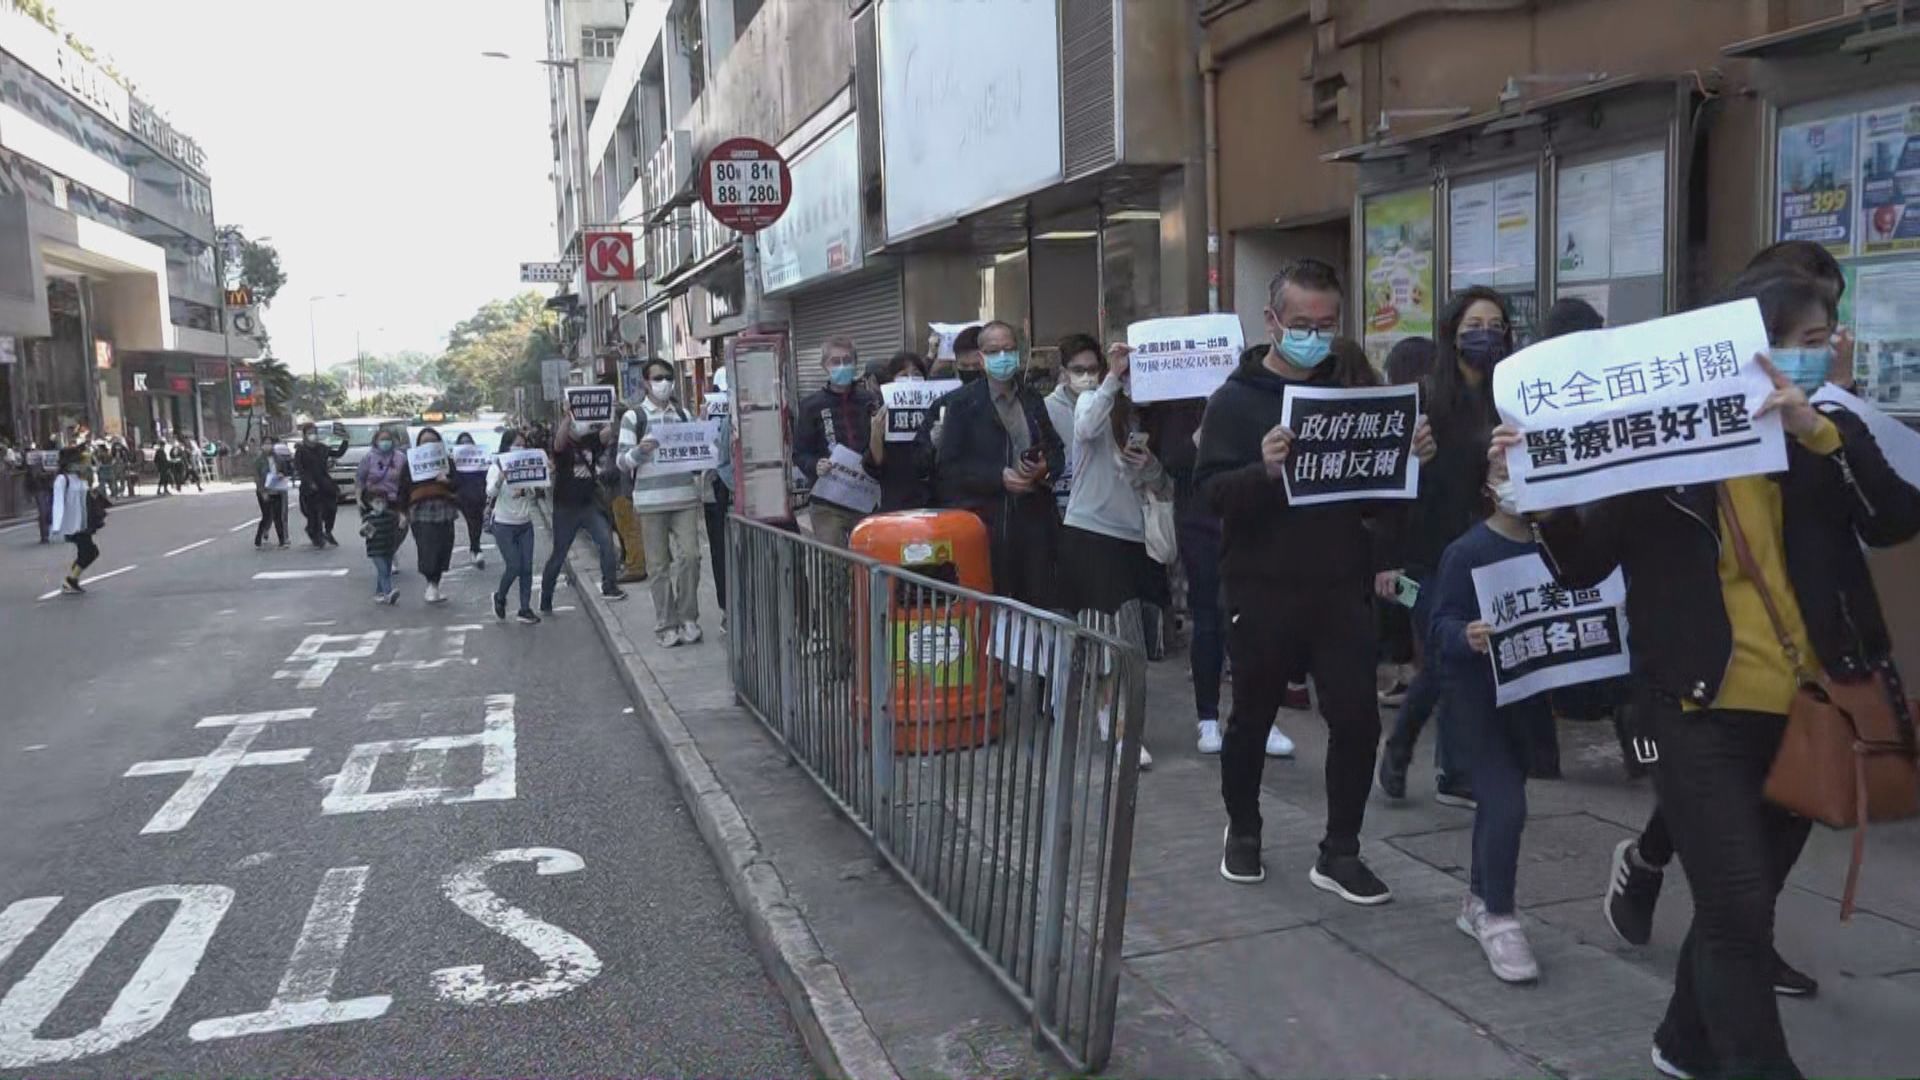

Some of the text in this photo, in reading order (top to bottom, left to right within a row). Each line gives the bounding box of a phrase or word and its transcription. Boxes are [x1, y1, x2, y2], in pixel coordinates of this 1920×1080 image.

[1814, 189, 1846, 213] 399
[597, 240, 626, 275] K
[1517, 340, 1739, 416] 快全面封關
[893, 390, 946, 406] 保護火
[1299, 410, 1405, 441] 政府無良
[1525, 393, 1752, 469] 醫療唔好慳
[1295, 448, 1400, 482] 出爾反爾
[0, 846, 603, 1068] STO
